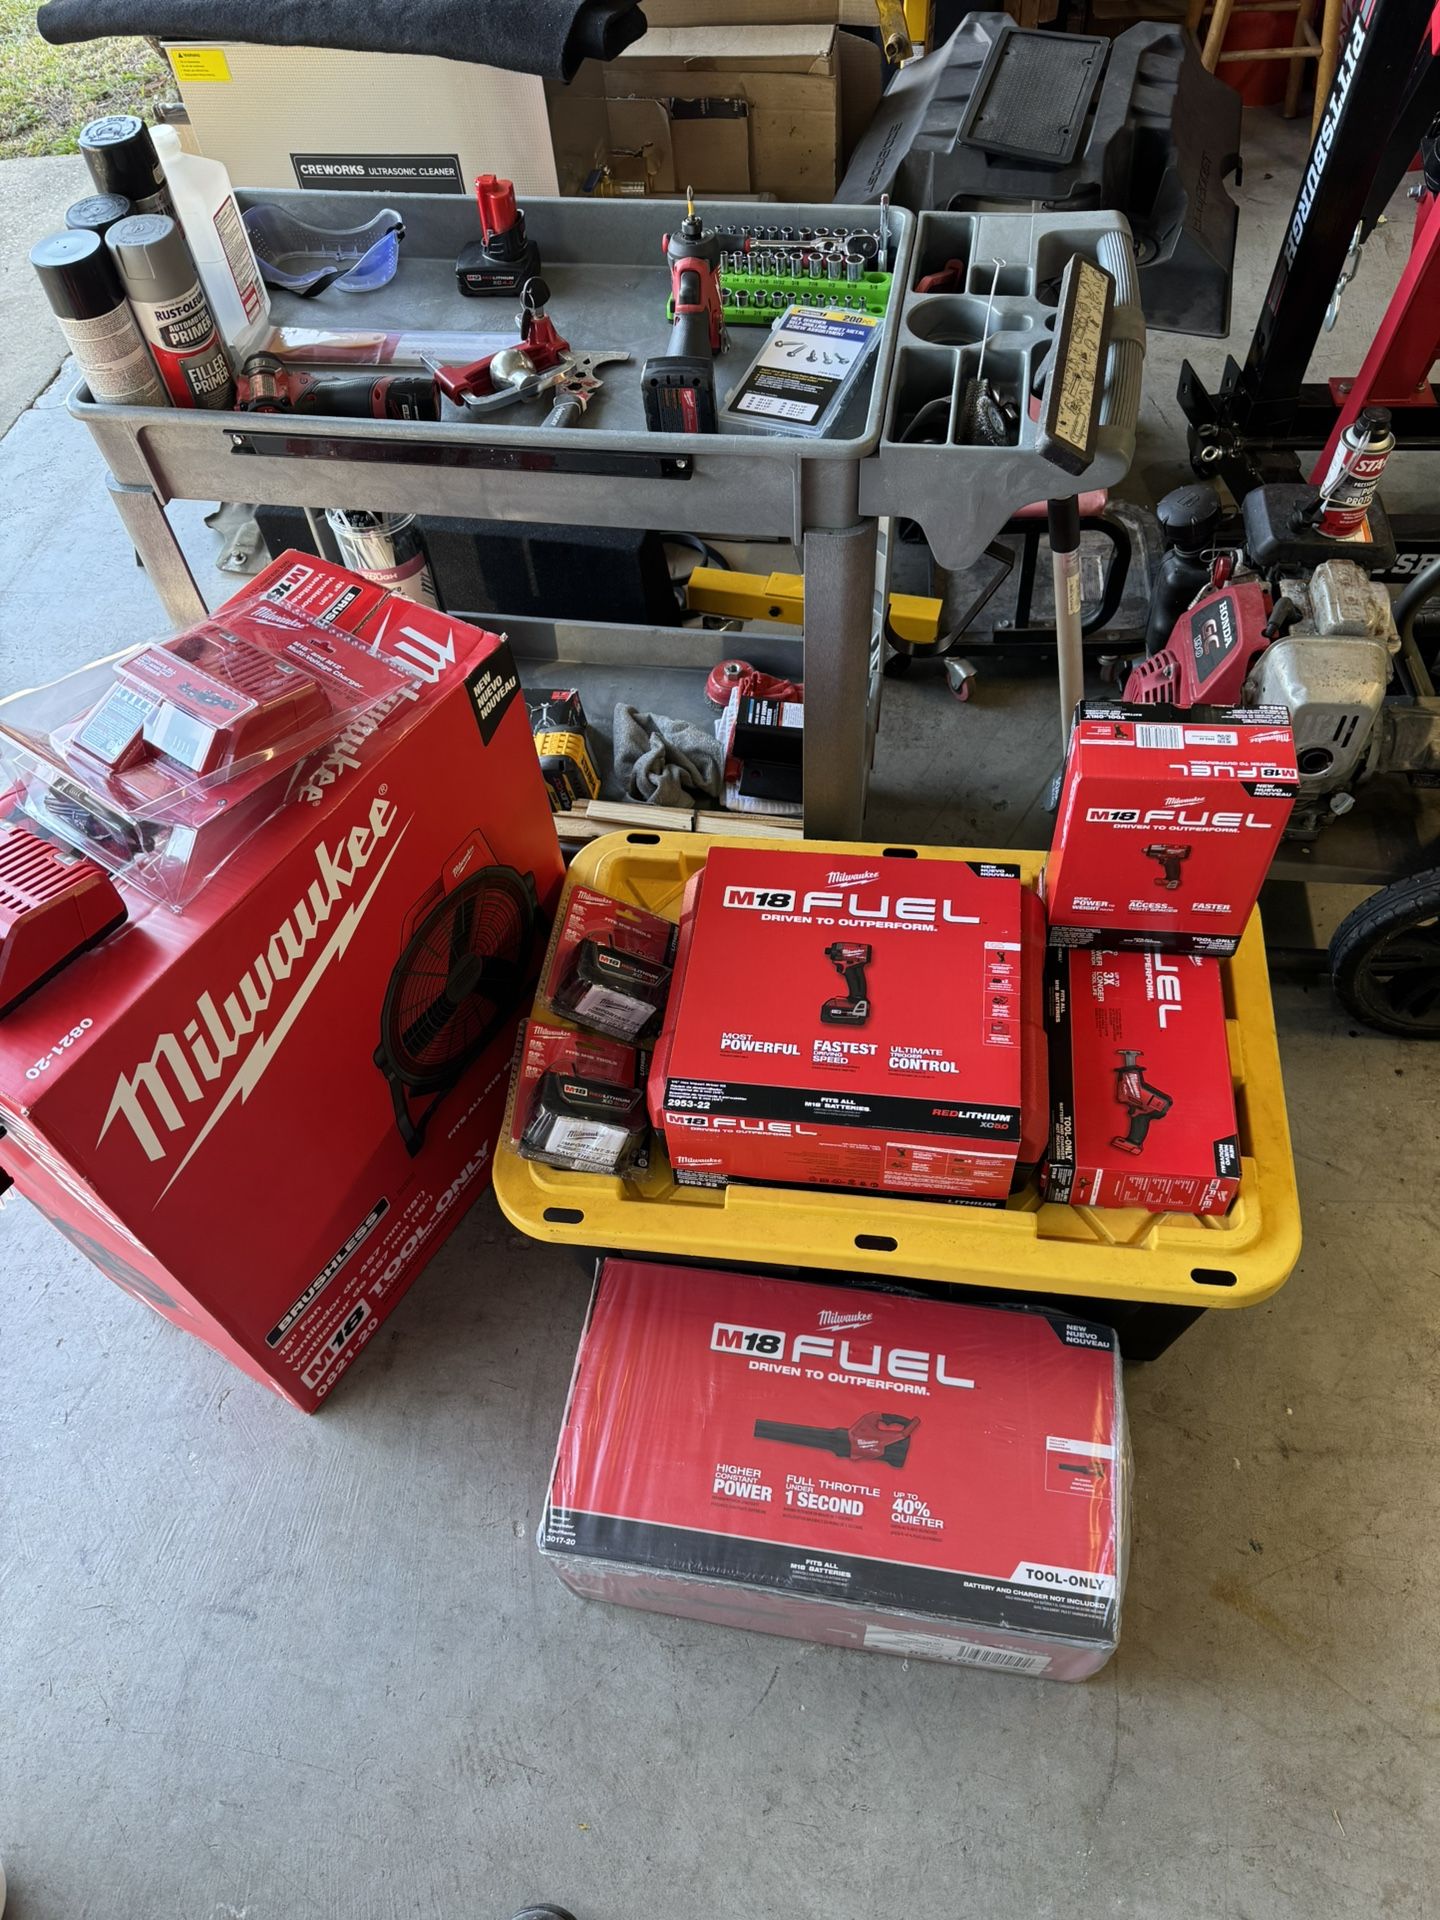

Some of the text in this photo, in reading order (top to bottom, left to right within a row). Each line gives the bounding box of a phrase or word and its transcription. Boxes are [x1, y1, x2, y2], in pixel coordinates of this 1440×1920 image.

[1284, 15, 1366, 271] PITTSBURGH
[300, 164, 455, 176] CREWORKS ULTRASONIC CLEANER
[169, 317, 213, 346] PRIMER
[188, 353, 225, 382] FILLER
[192, 366, 230, 395] PRIMER
[1219, 600, 1234, 649] HONDA
[1202, 618, 1220, 655] GC
[333, 669, 364, 688] Charger
[472, 670, 493, 698] NEW
[477, 675, 503, 709] NUEVO
[480, 675, 517, 720] NOUVEAU
[1169, 764, 1295, 778] M18 FUEL
[1088, 811, 1272, 829] M18 FUEL
[1112, 823, 1151, 831] DRIVEN
[825, 871, 880, 885] Milwaukee
[728, 890, 981, 924] M18 FUEL
[761, 913, 938, 932] DRIVEN TO OUTPERFORM.
[95, 796, 402, 1162] Milwaukee
[1096, 971, 1104, 1002] LONGER
[1103, 971, 1115, 985] 3X
[722, 1032, 753, 1041] MOST
[25, 1017, 94, 1080] 0821-20
[720, 1038, 801, 1056] POWERFUL
[813, 1039, 878, 1056] FASTEST
[890, 1046, 943, 1056] ULTIMATE
[812, 1055, 849, 1065] SPEED
[888, 1057, 960, 1073] CONTROL
[667, 1098, 711, 1110] 2953-22
[931, 1107, 1011, 1122] REDLITHIUM
[668, 1115, 818, 1136] M18 FUEL
[675, 1155, 723, 1167] Milwaukee
[1218, 1143, 1226, 1174] NOUVEAU
[1223, 1143, 1231, 1166] NUEVO
[368, 1139, 490, 1299] TOOL-ONLY
[277, 1211, 378, 1333] BRUSHLESS
[285, 1296, 341, 1364] Ventilador
[343, 1276, 358, 1295] de
[359, 1246, 381, 1274] 457
[382, 1220, 402, 1245] mm
[292, 1300, 350, 1372] Ventilateur
[352, 1280, 367, 1298] de
[368, 1250, 389, 1278] 457
[390, 1225, 410, 1249] mm
[300, 1306, 322, 1332] Fan
[817, 1309, 874, 1325] Milwaukee
[1066, 1324, 1087, 1332] NEW
[1066, 1330, 1098, 1340] NUEVO
[306, 1303, 367, 1384] M18
[1066, 1336, 1110, 1348] NOUVEAU
[315, 1317, 379, 1398] 0821-20
[715, 1328, 975, 1389] M18 FUEL
[748, 1360, 931, 1396] DRIVEN TO OUTPERFORM.
[714, 1472, 758, 1485] CONSTANT
[716, 1463, 762, 1478] HIGHER
[712, 1478, 773, 1503] POWER
[785, 1483, 814, 1494] UNDER
[786, 1474, 881, 1498] FULL THROTTLE
[893, 1490, 919, 1501] UP TO
[785, 1490, 793, 1505] 1
[796, 1492, 864, 1517] SECOND
[892, 1498, 931, 1518] 40%
[891, 1513, 944, 1529] QUIETER
[545, 1535, 576, 1546] 3017-20
[790, 1562, 806, 1571] M18
[808, 1566, 851, 1578] BATTERIES
[805, 1558, 839, 1569] FITS ALL
[1025, 1568, 1105, 1591] TOOL-ONLY
[963, 1581, 995, 1592] BATTERY
[996, 1586, 1012, 1594] AND
[1012, 1589, 1049, 1600] CHARGER
[1049, 1594, 1066, 1602] NOT
